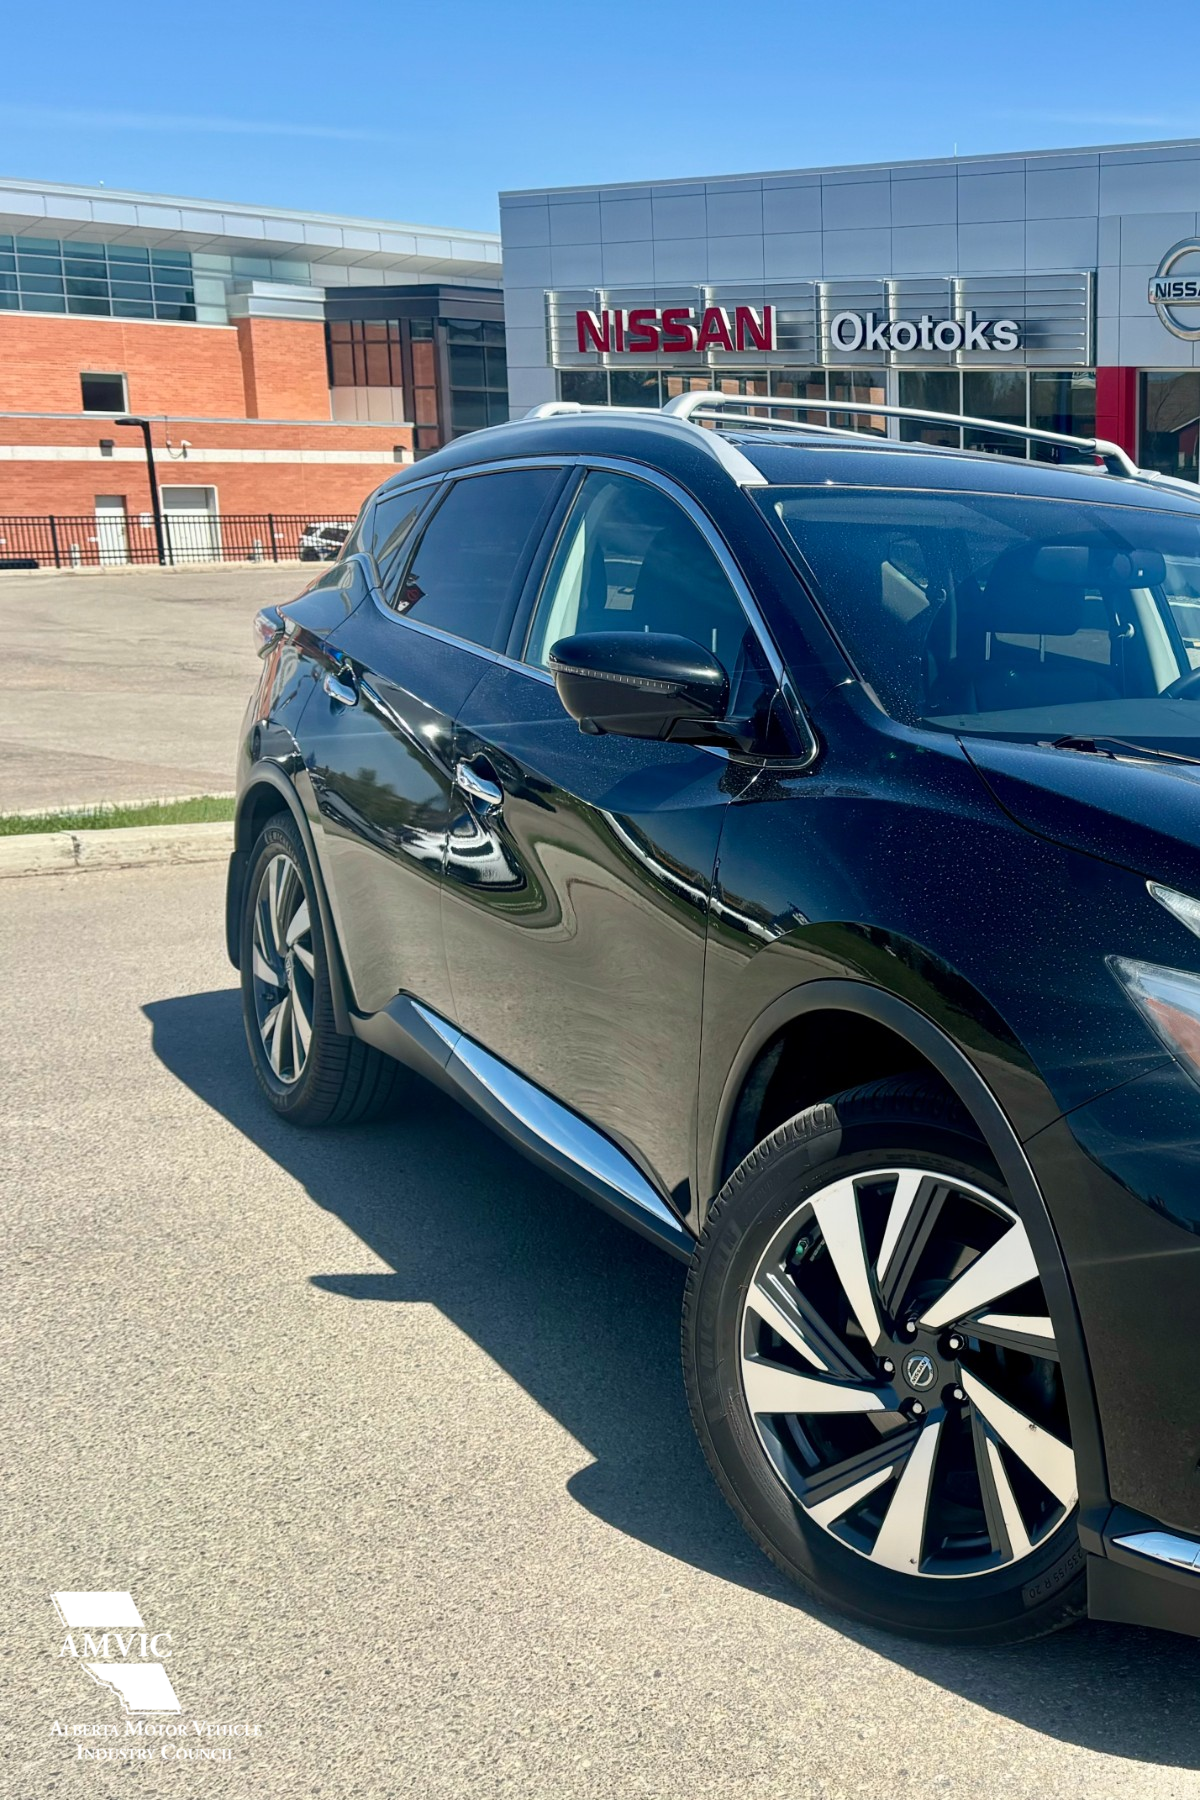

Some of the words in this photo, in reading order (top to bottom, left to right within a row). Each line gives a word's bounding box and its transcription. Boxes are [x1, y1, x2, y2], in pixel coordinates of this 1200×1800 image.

[576, 305, 777, 353] NISSAN
[830, 310, 1020, 352] Okotoks
[911, 1360, 927, 1382] NISSAN
[1029, 1585, 1042, 1599] 20
